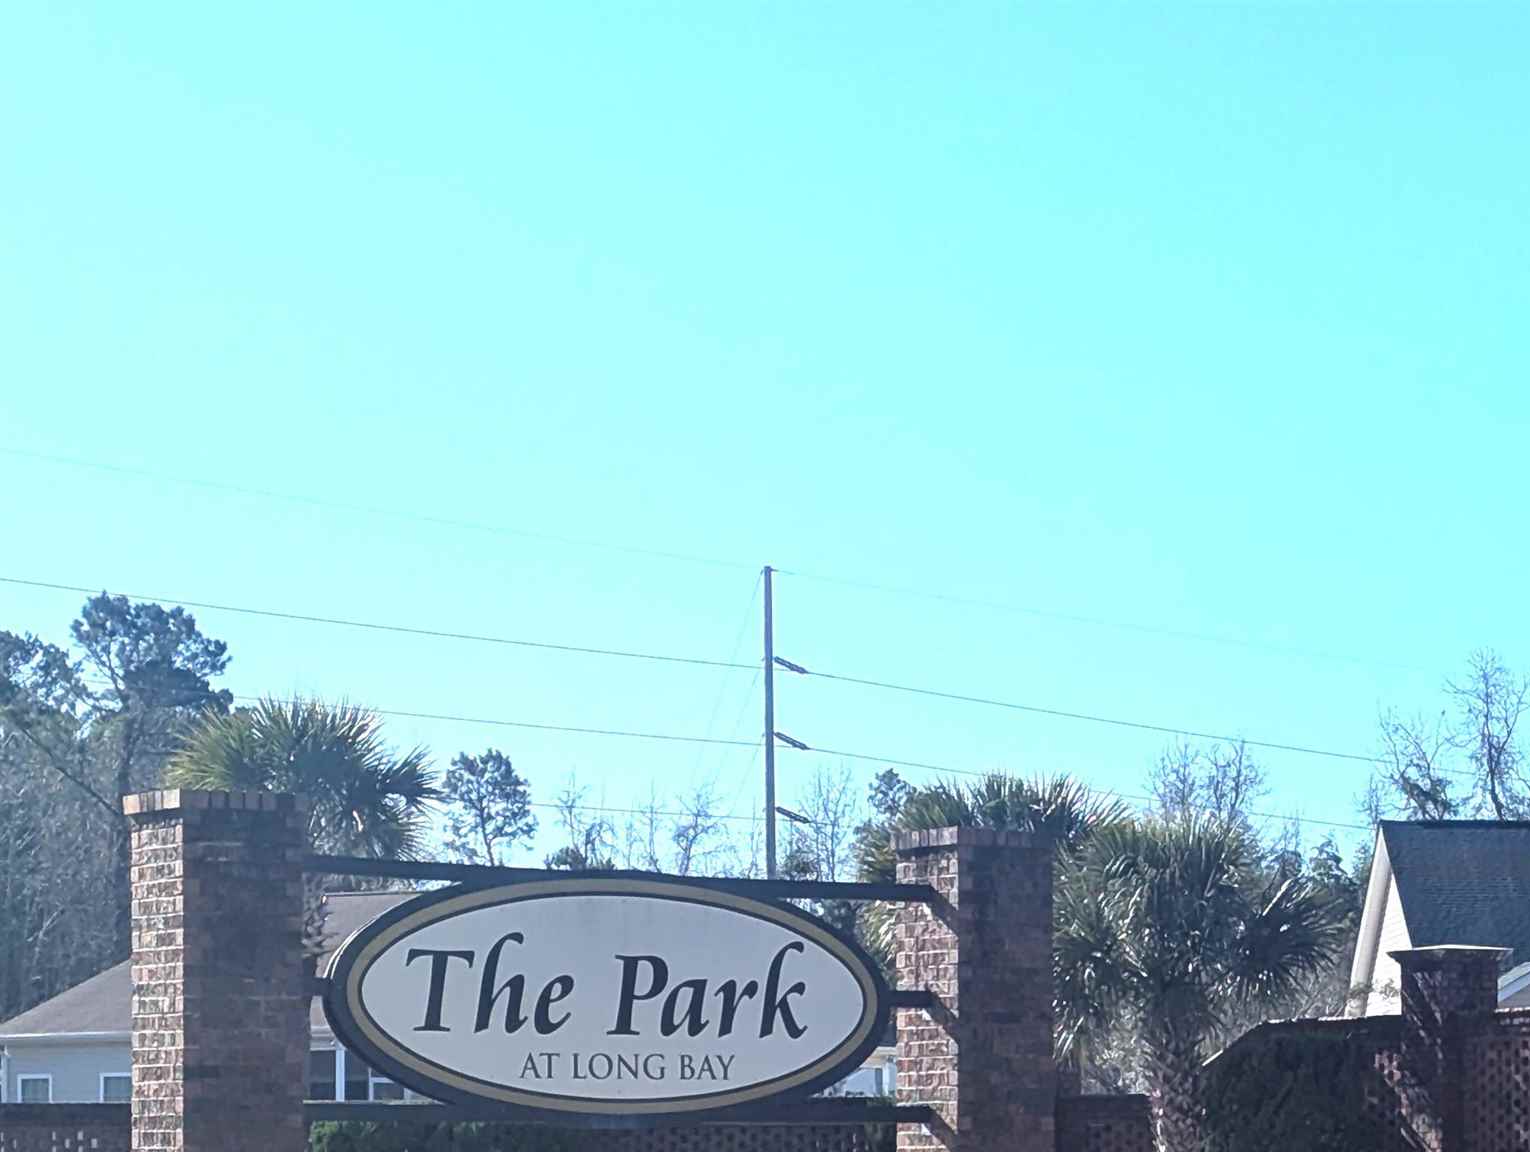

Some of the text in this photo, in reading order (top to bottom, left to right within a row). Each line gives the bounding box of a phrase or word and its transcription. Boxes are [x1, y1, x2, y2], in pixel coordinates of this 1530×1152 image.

[405, 931, 809, 1040] The Park
[519, 1052, 736, 1081] AT LONG BAY
